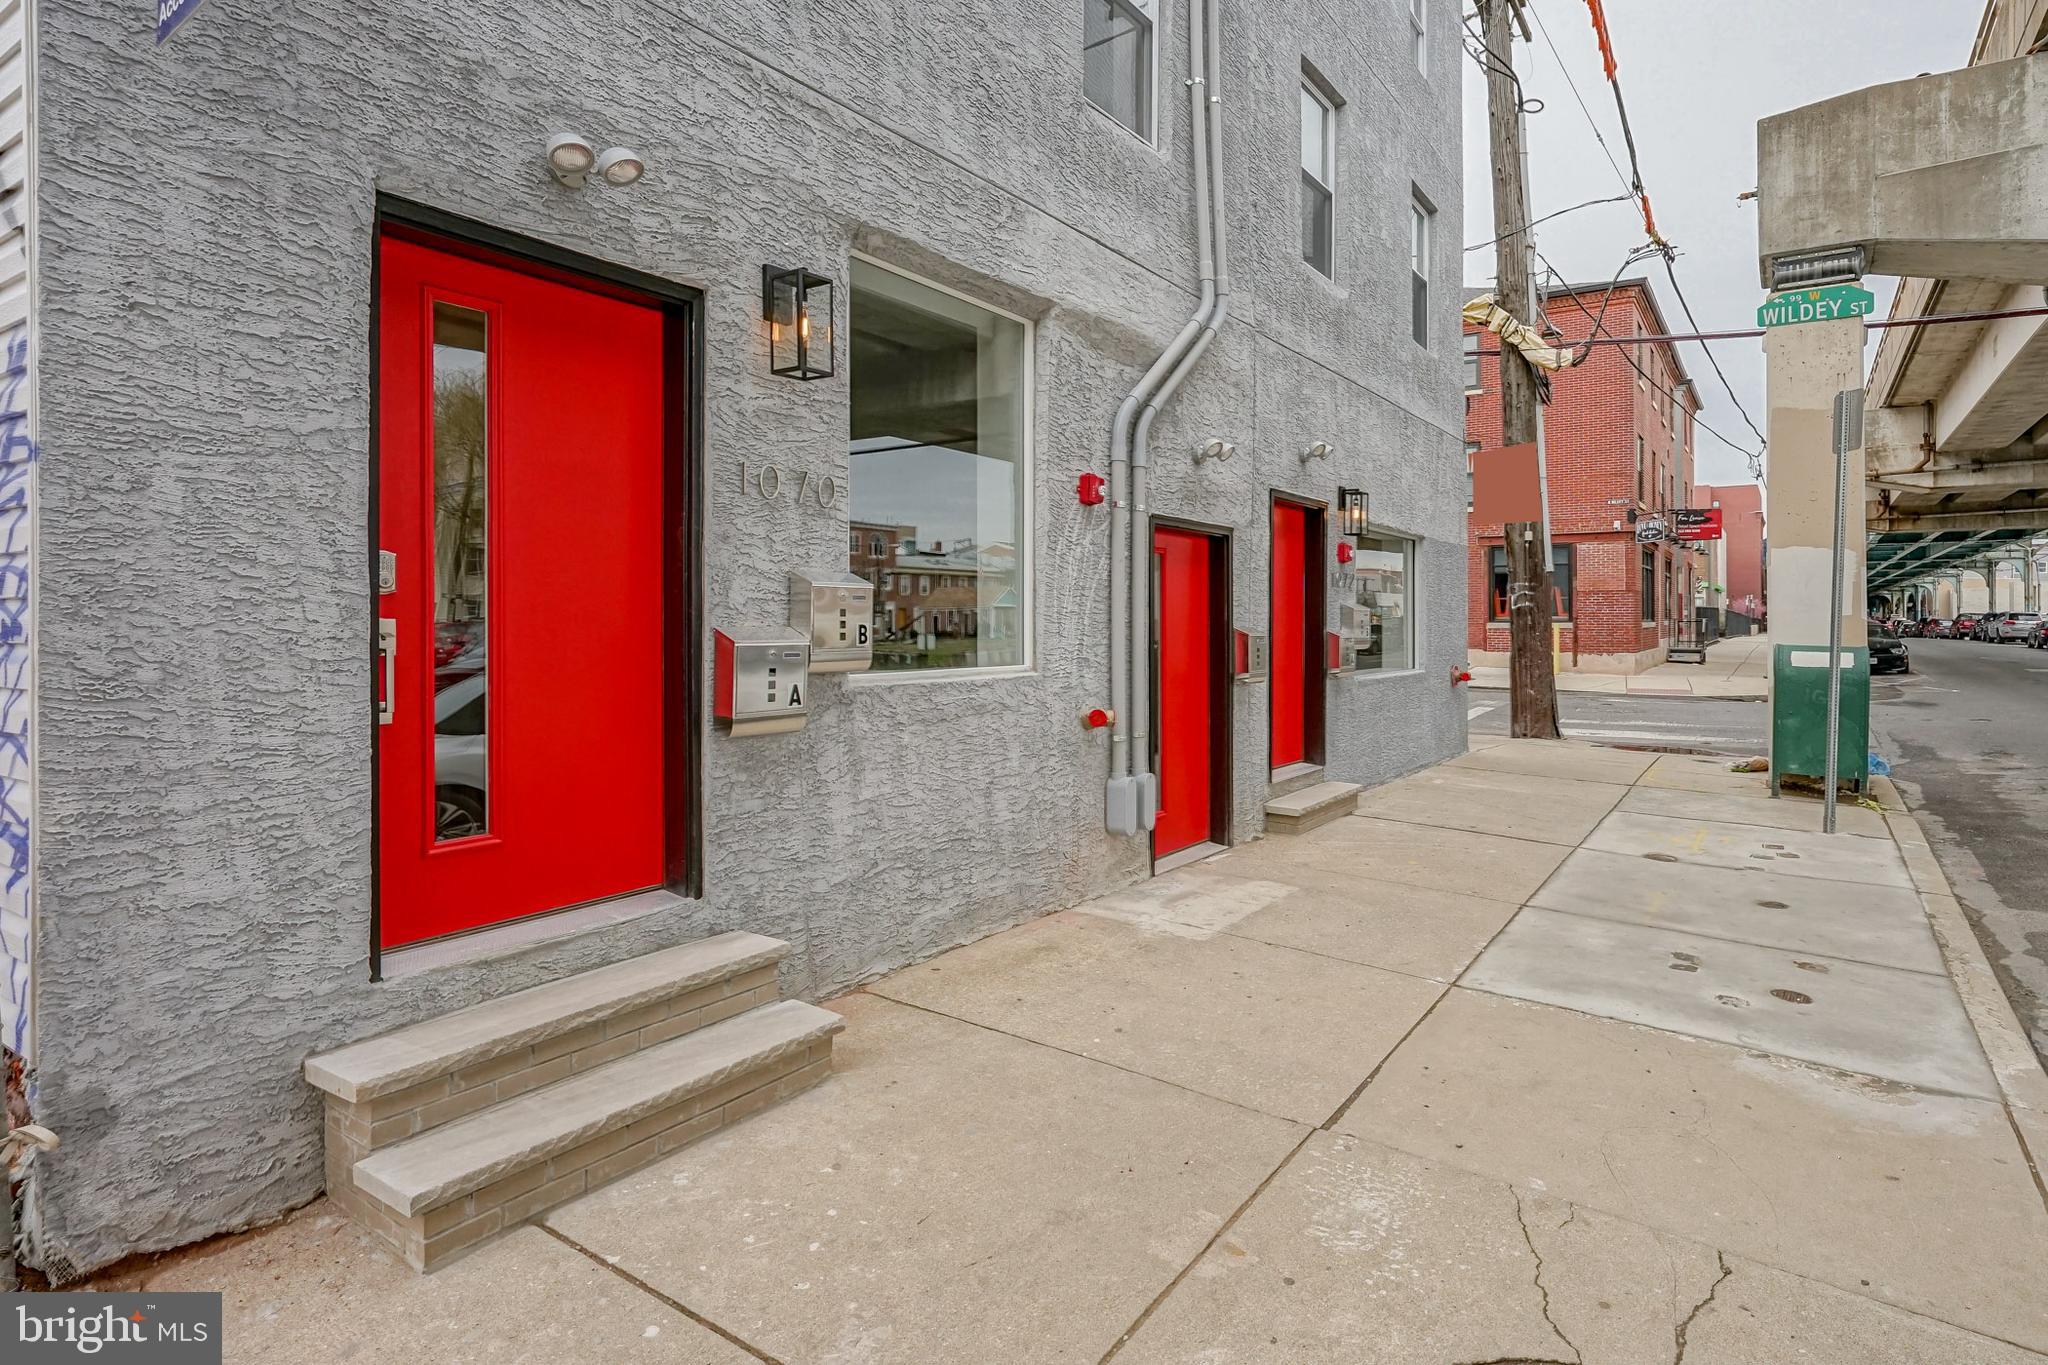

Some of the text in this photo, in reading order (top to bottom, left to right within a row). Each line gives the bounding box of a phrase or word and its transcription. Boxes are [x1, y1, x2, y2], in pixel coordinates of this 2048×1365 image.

[1809, 292, 1820, 300] W
[1763, 299, 1868, 325] WILDEY ST
[740, 461, 836, 508] 1070
[858, 624, 868, 645] B
[788, 683, 802, 706] A
